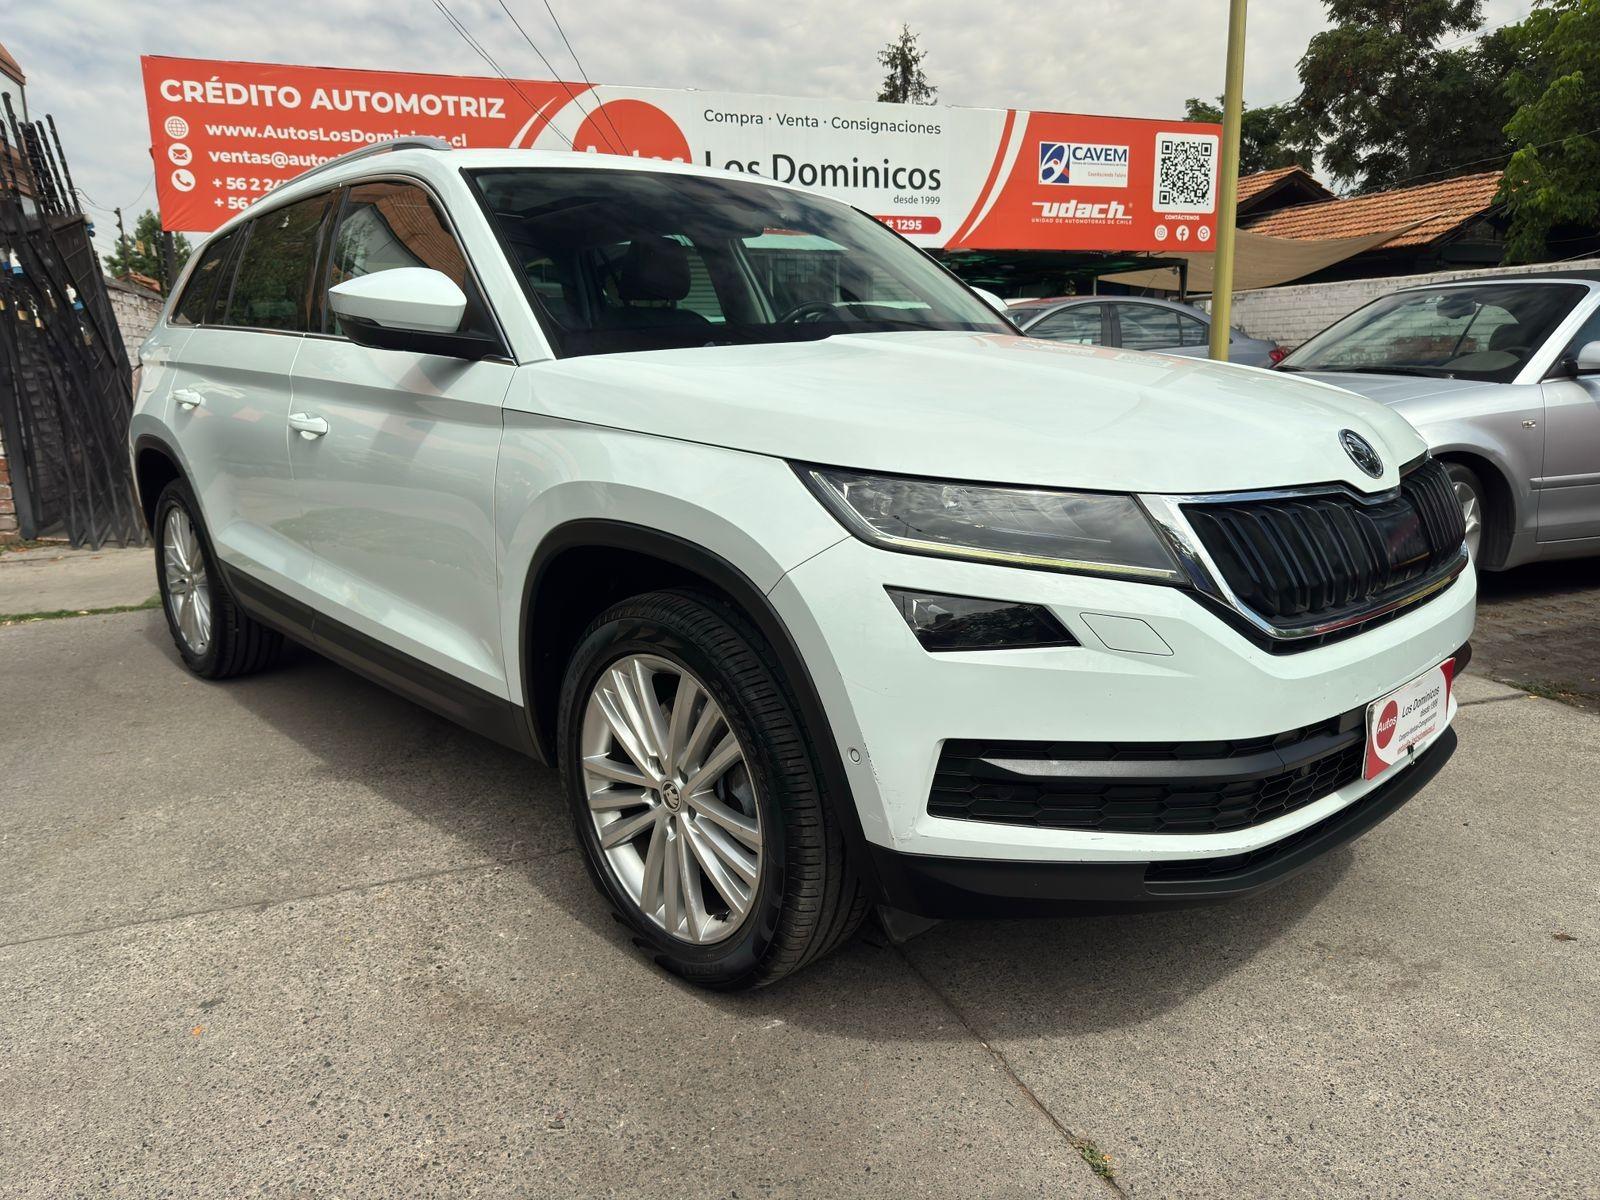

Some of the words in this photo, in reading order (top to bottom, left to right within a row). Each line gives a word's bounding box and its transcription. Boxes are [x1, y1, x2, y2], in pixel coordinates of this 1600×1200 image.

[160, 76, 302, 109] CRÉDITO
[310, 88, 506, 119] AUTOMOTRIZ
[703, 109, 763, 126] Compra
[776, 113, 819, 128] Venta
[831, 117, 942, 135] Consignaciones
[1072, 146, 1128, 162] CAVEM
[772, 153, 942, 191] Dominicos
[226, 176, 248, 191] 56
[249, 177, 261, 191] 2
[228, 196, 249, 210] 56
[893, 194, 919, 204] desde
[920, 196, 941, 205] 1999
[1032, 199, 1133, 219] udach
[896, 220, 923, 231] 1295
[1064, 218, 1106, 226] AUTOMOTORAS
[1402, 705, 1412, 718] Los
[1413, 686, 1439, 710] Dominicos
[1377, 716, 1397, 734] Autos
